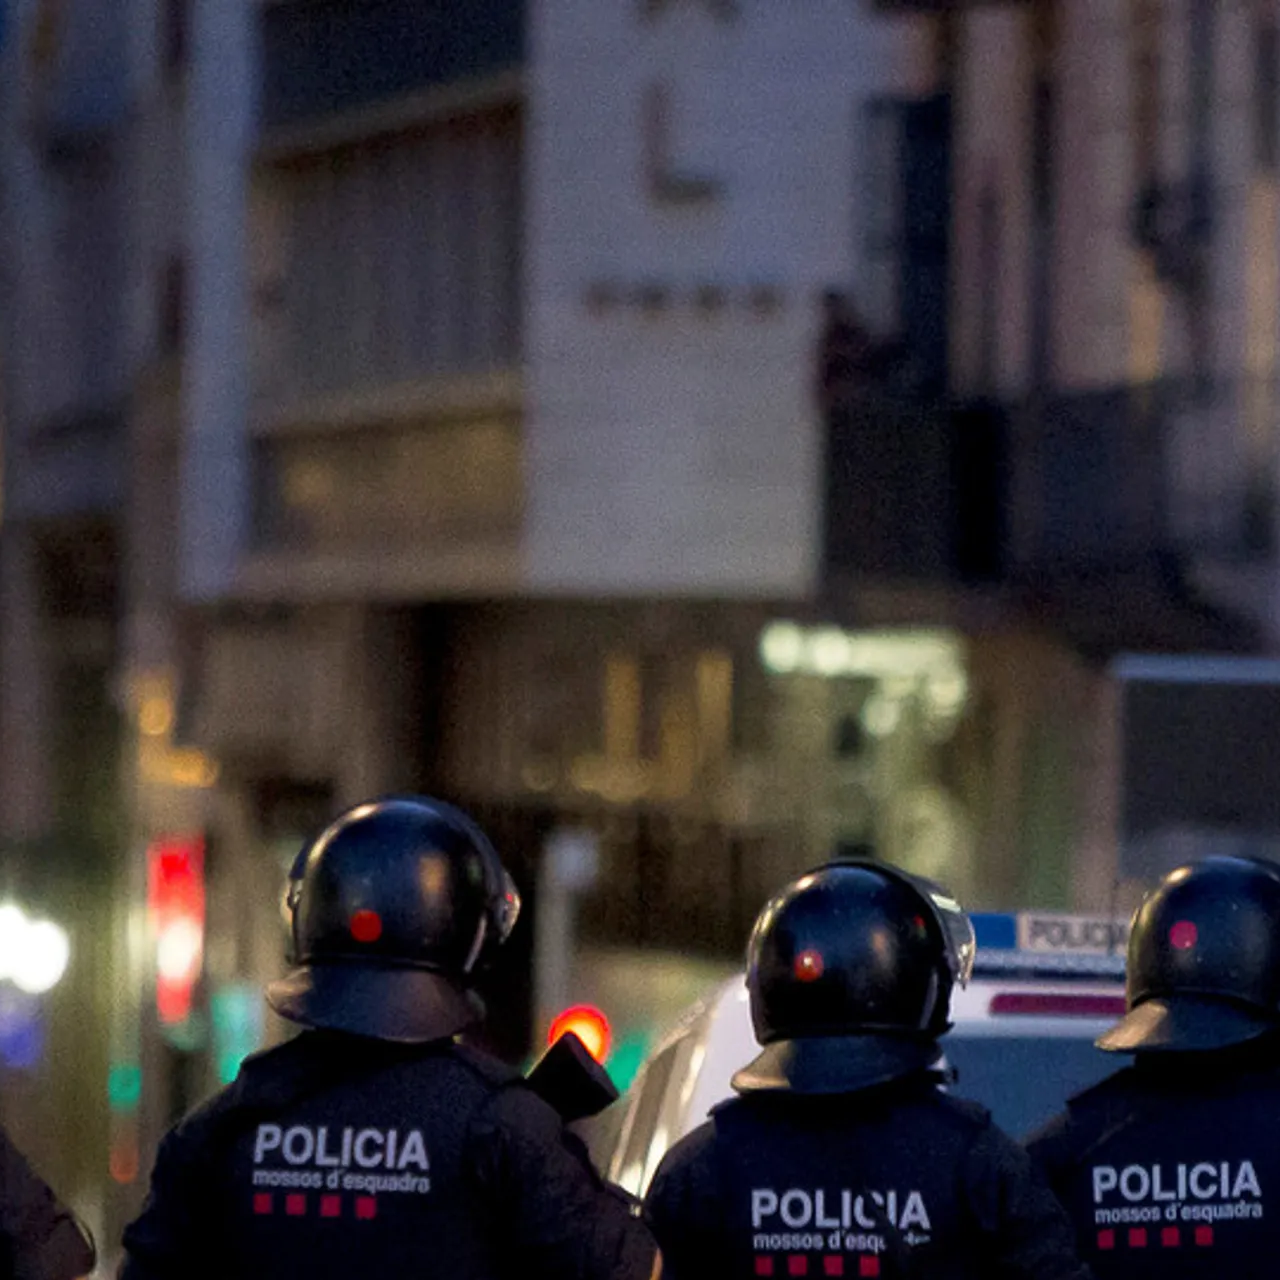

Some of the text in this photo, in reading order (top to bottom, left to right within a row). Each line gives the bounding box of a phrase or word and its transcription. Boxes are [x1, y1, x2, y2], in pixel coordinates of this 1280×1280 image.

[253, 1124, 430, 1171] POLICIA
[252, 1168, 323, 1188] mossos
[1092, 1160, 1262, 1203] POLICIA
[750, 1188, 931, 1231] POLICIA
[1094, 1205, 1161, 1224] mossos
[753, 1231, 824, 1250] mossos
